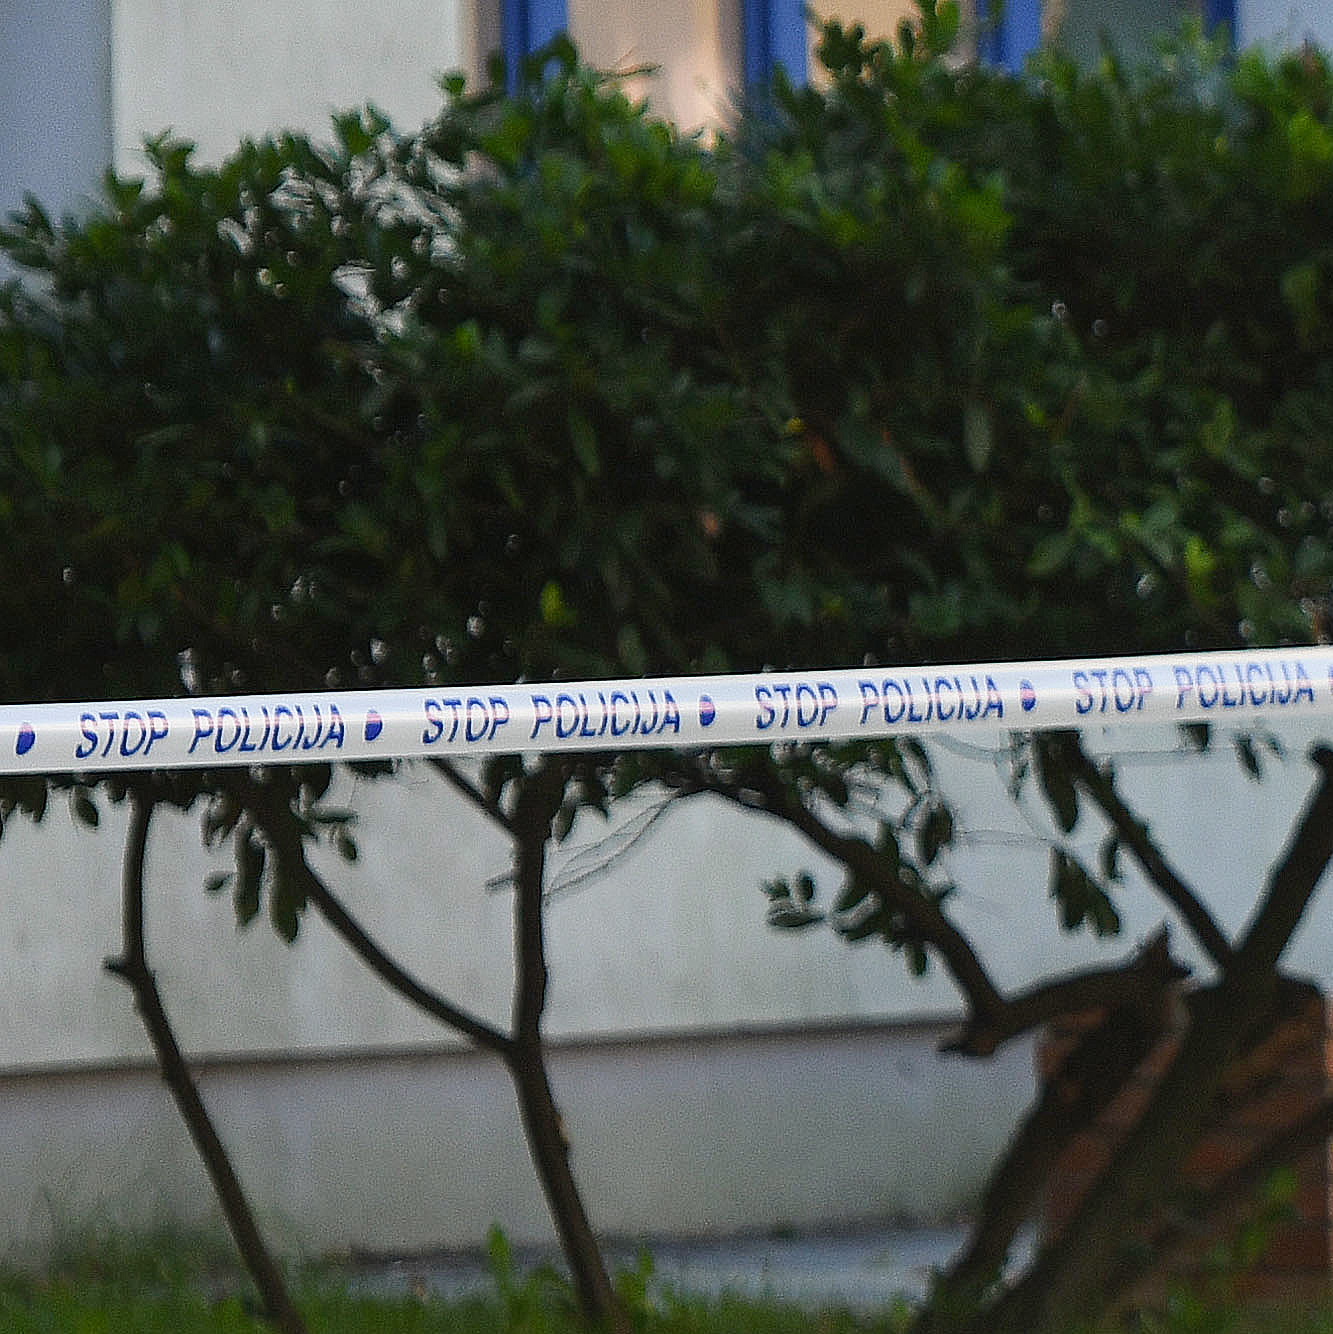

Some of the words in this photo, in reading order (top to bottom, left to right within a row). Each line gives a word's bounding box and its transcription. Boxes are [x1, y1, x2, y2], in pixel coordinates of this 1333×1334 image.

[77, 711, 170, 760] STOP
[190, 704, 347, 755] POLICIJA
[423, 697, 511, 746] STOP
[531, 690, 683, 741] POLICIJA
[756, 683, 840, 731] STOP
[859, 676, 1006, 726] POLICIJA
[1073, 669, 1156, 717] STOP
[1174, 662, 1317, 711] POLICIJA
